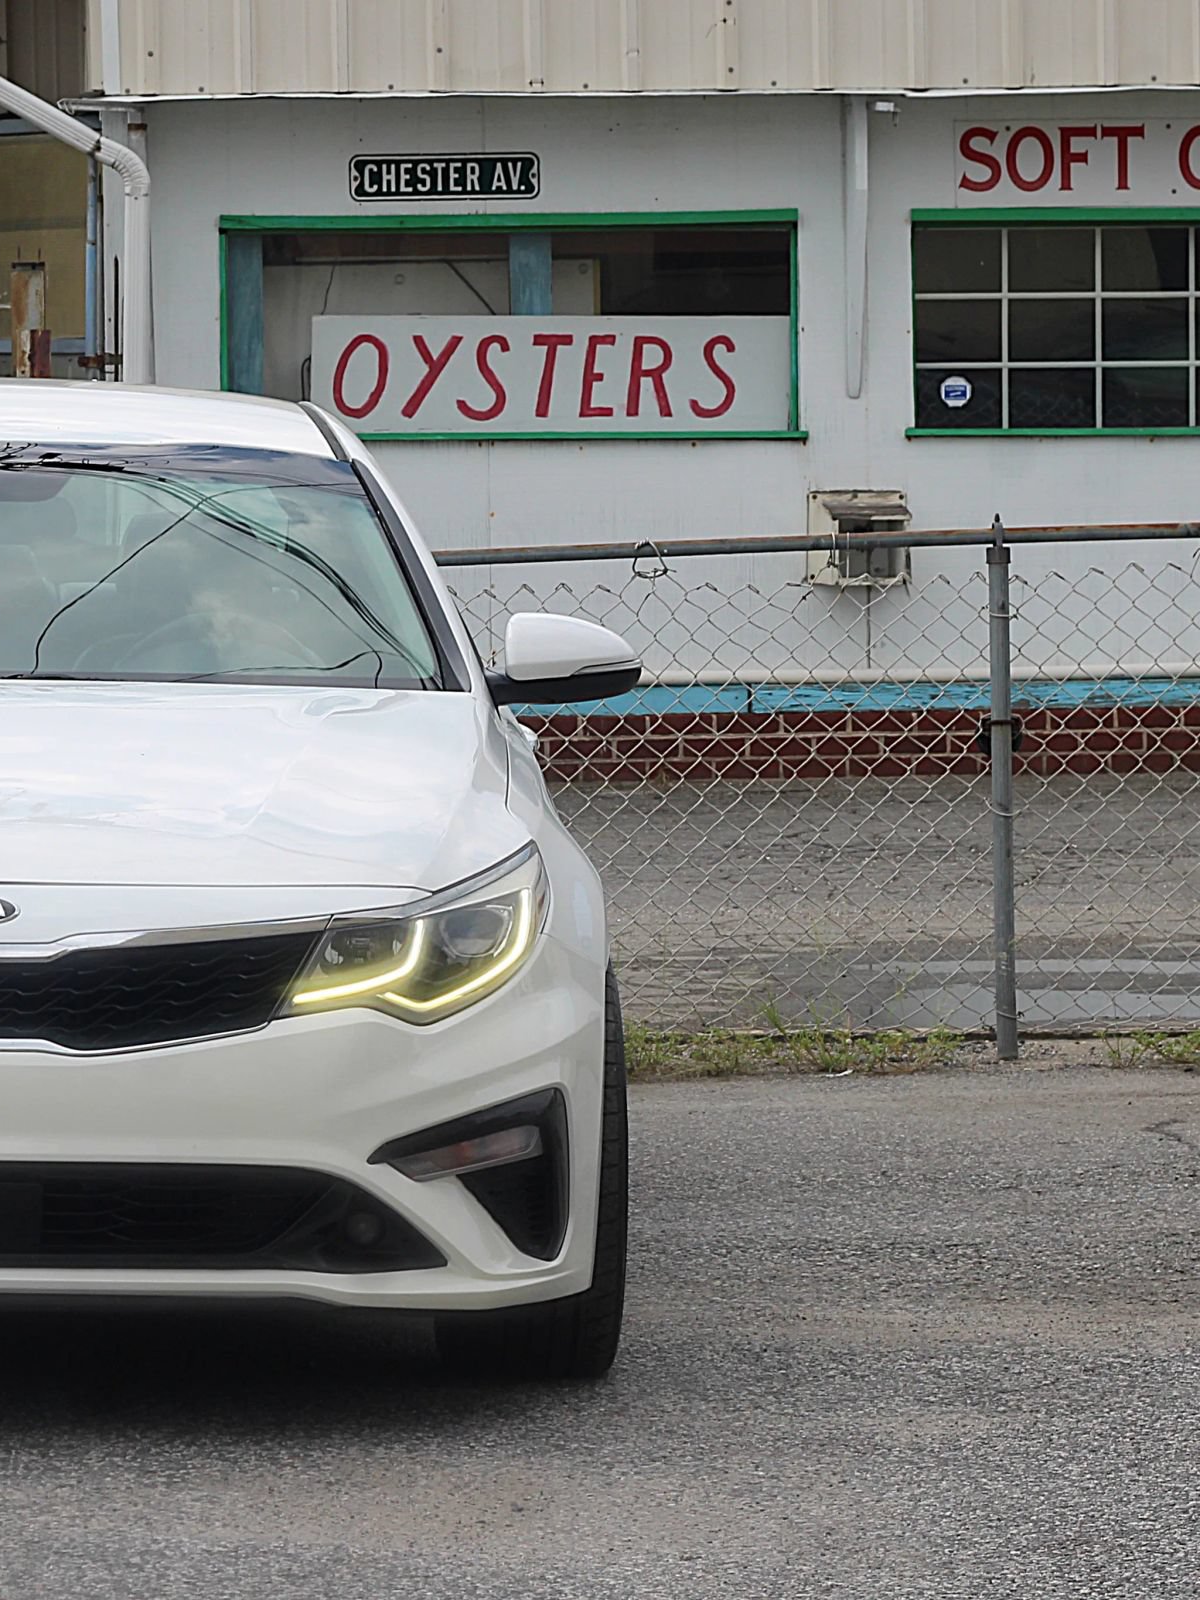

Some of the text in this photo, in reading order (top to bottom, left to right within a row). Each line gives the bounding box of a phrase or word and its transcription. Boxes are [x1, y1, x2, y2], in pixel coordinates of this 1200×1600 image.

[364, 161, 526, 193] CHESTER AV.
[958, 123, 1145, 192] SOFT
[333, 333, 736, 422] OYSTERS
